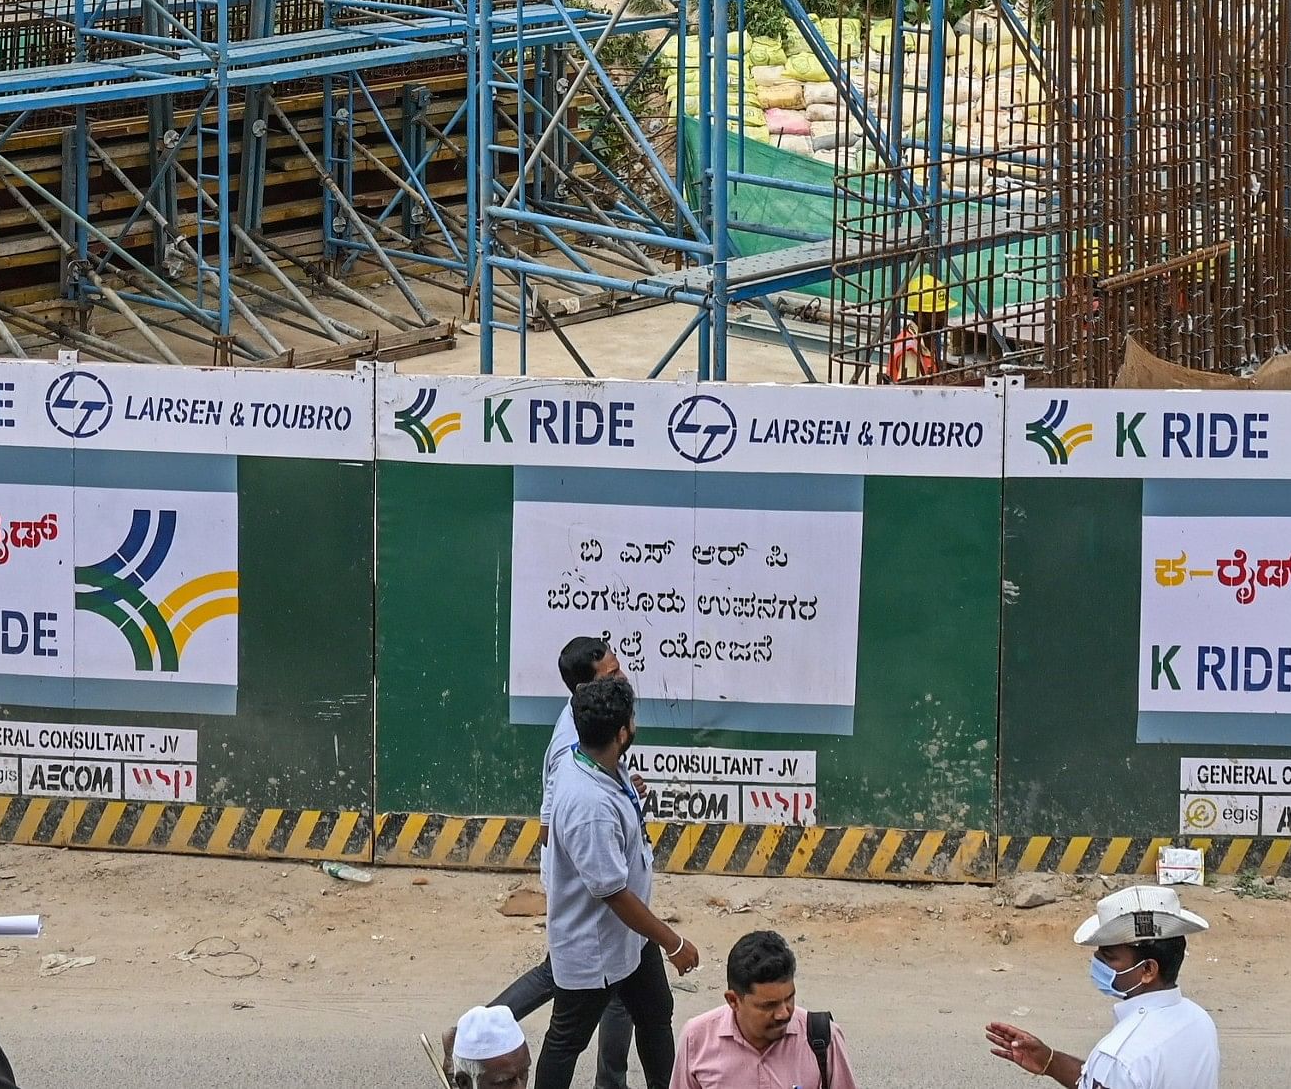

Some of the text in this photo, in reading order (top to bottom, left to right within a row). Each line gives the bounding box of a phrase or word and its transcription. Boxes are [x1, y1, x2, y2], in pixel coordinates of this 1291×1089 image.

[125, 396, 351, 431] LARSEN & TOUBRO
[484, 397, 634, 447] K RIDE
[749, 419, 983, 447] LARSEN & TOUBRO
[1116, 412, 1268, 458] K RIDE
[581, 539, 788, 567] ಬಿ ಎಸ್ ಆರ್ ಪಿ
[548, 583, 817, 620] ಬೆಂಗಳೂರು ಉಪನಗರ
[659, 632, 773, 668] ಯೋಜನೆ
[1151, 645, 1181, 690] K
[39, 730, 145, 752] CONSULTANT
[159, 735, 179, 753] JV
[29, 764, 112, 792] AECOM
[654, 754, 763, 775] CONSULTANT
[778, 758, 798, 777] JV
[1197, 765, 1277, 785] GENERAL
[643, 789, 728, 820] AECOM
[1222, 805, 1258, 824] egis
